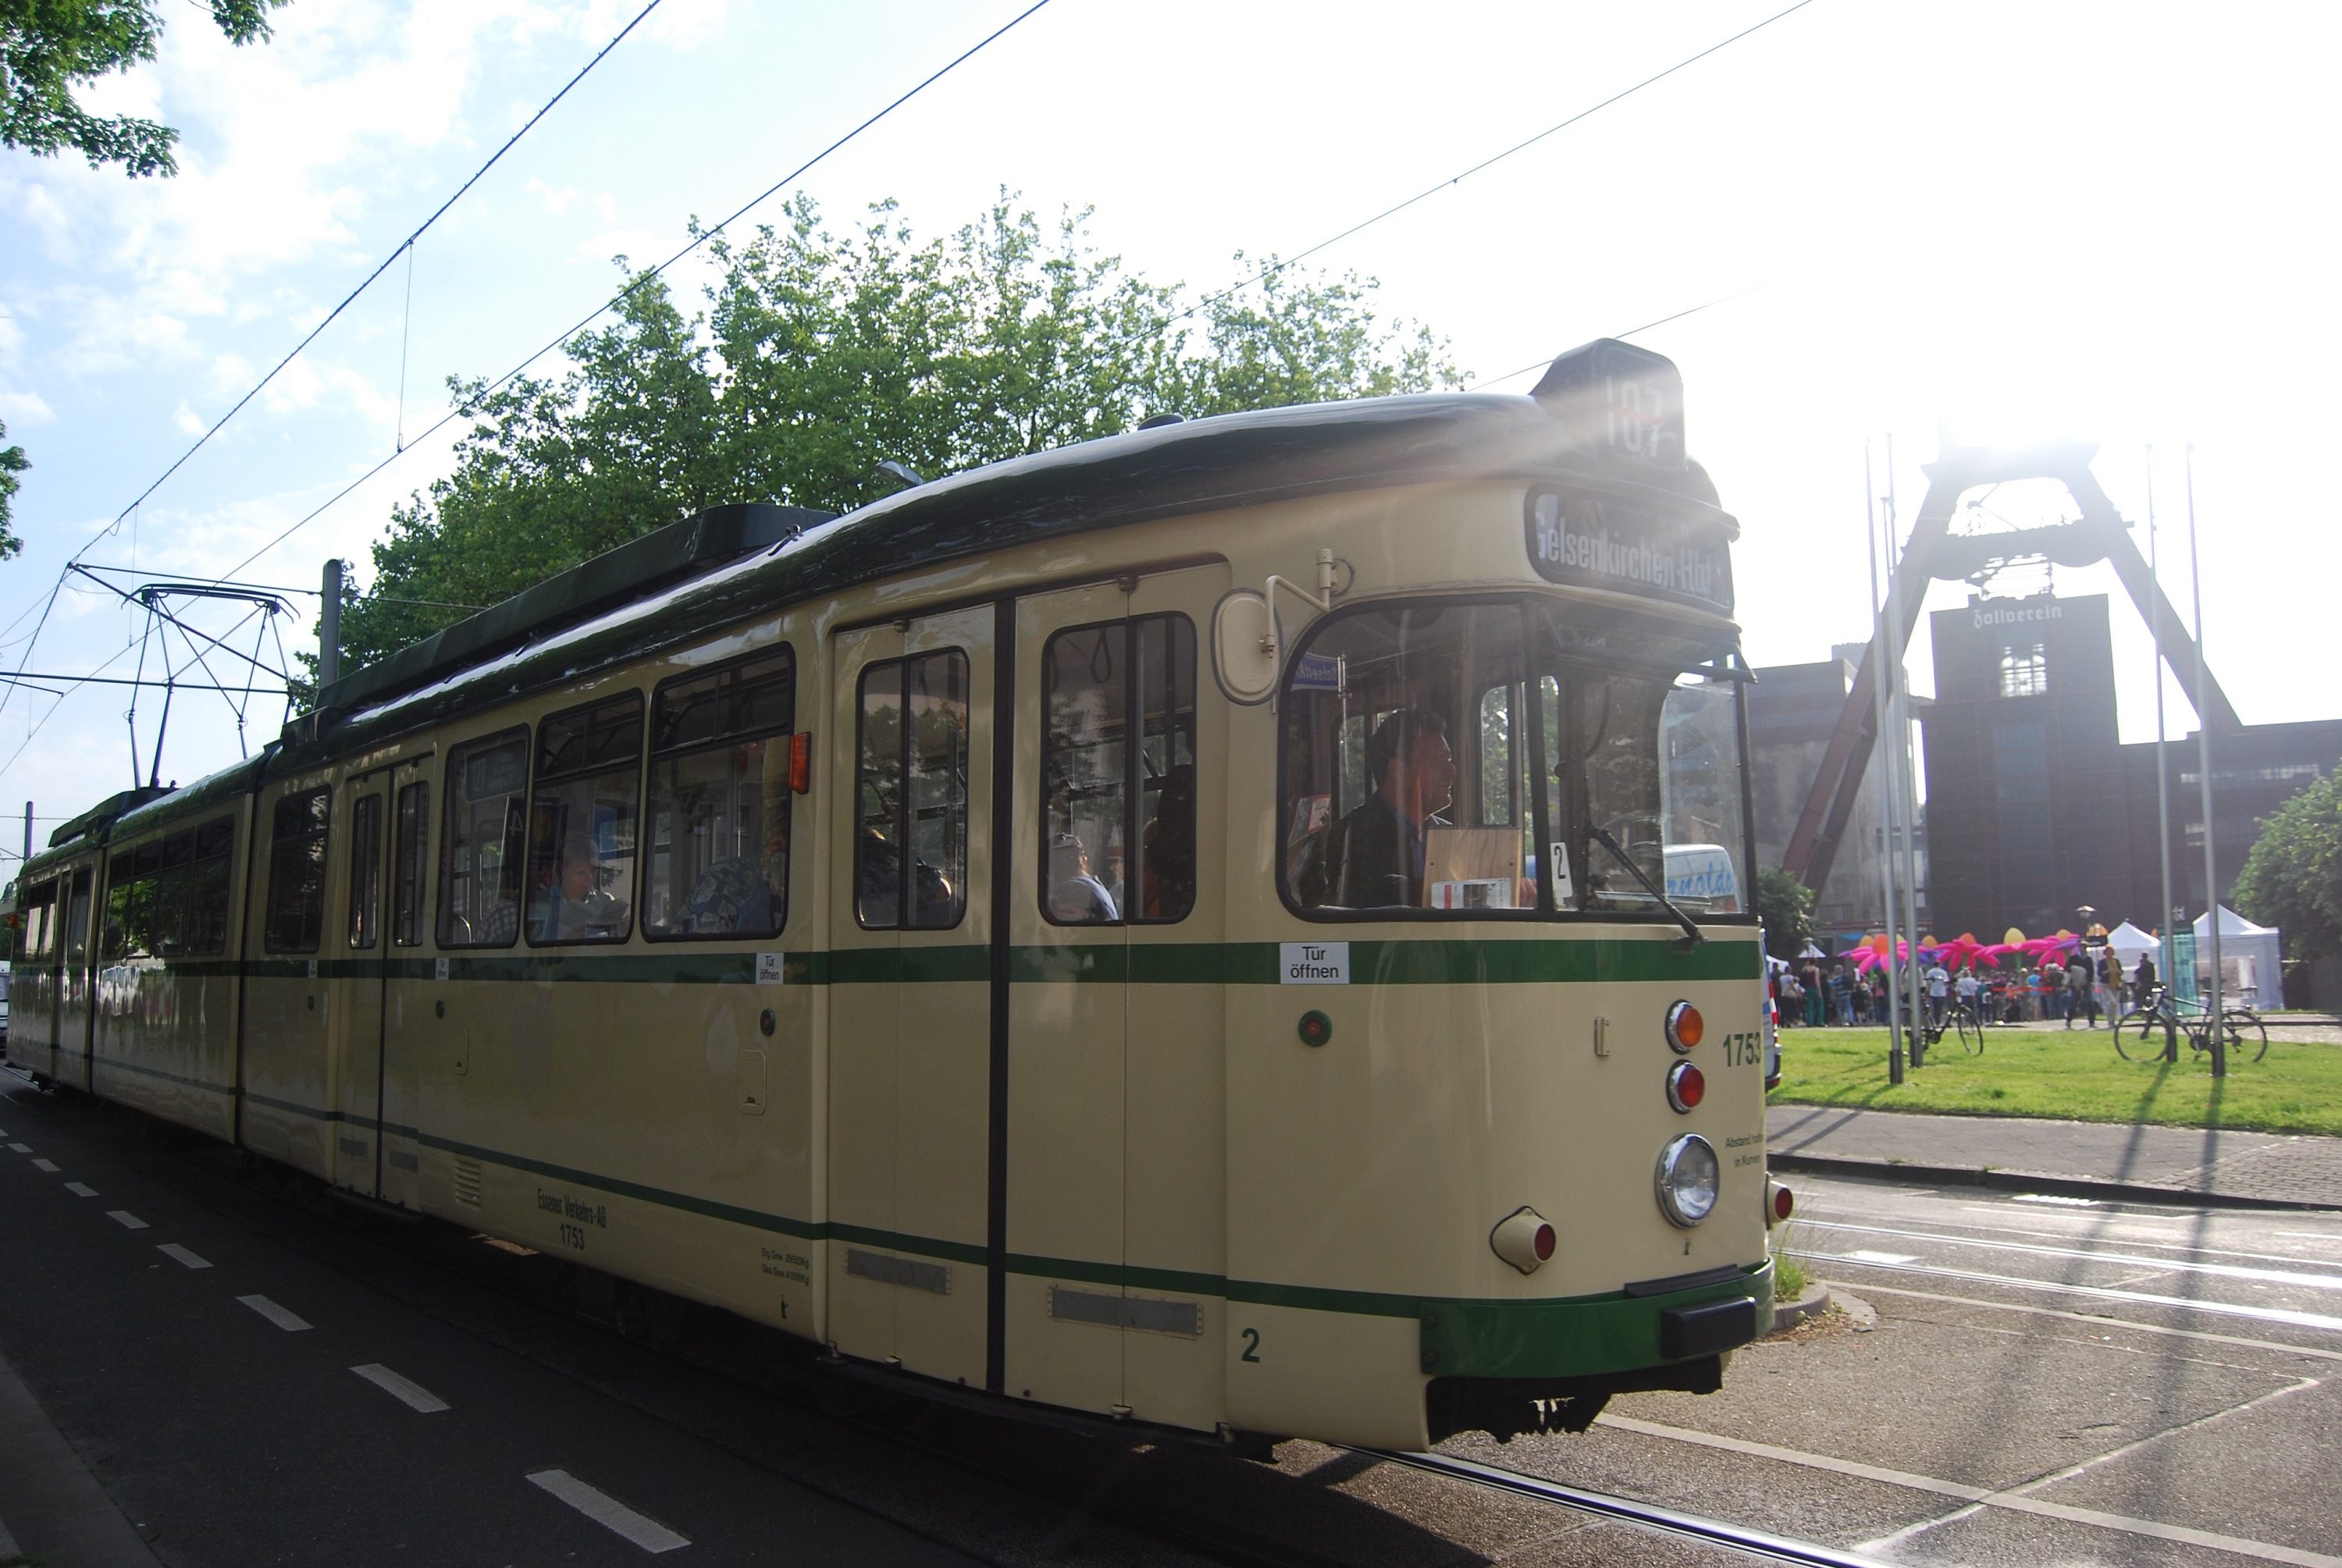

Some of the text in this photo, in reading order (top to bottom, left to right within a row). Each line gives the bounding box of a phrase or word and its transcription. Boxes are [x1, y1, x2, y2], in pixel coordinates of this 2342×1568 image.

[1606, 376, 1662, 457] 107
[1536, 511, 1675, 588] Gelsenkirchen
[1974, 605, 2063, 629] Zollverein
[1554, 845, 1565, 879] 2
[1301, 946, 1326, 961] Tür
[760, 969, 780, 980] öffnen
[1290, 964, 1339, 978] öffnen
[1723, 1032, 1762, 1067] 1753
[538, 1188, 607, 1228] Essener Verkehrs-AG
[560, 1222, 585, 1250] 1753
[1242, 1328, 1260, 1363] 2
